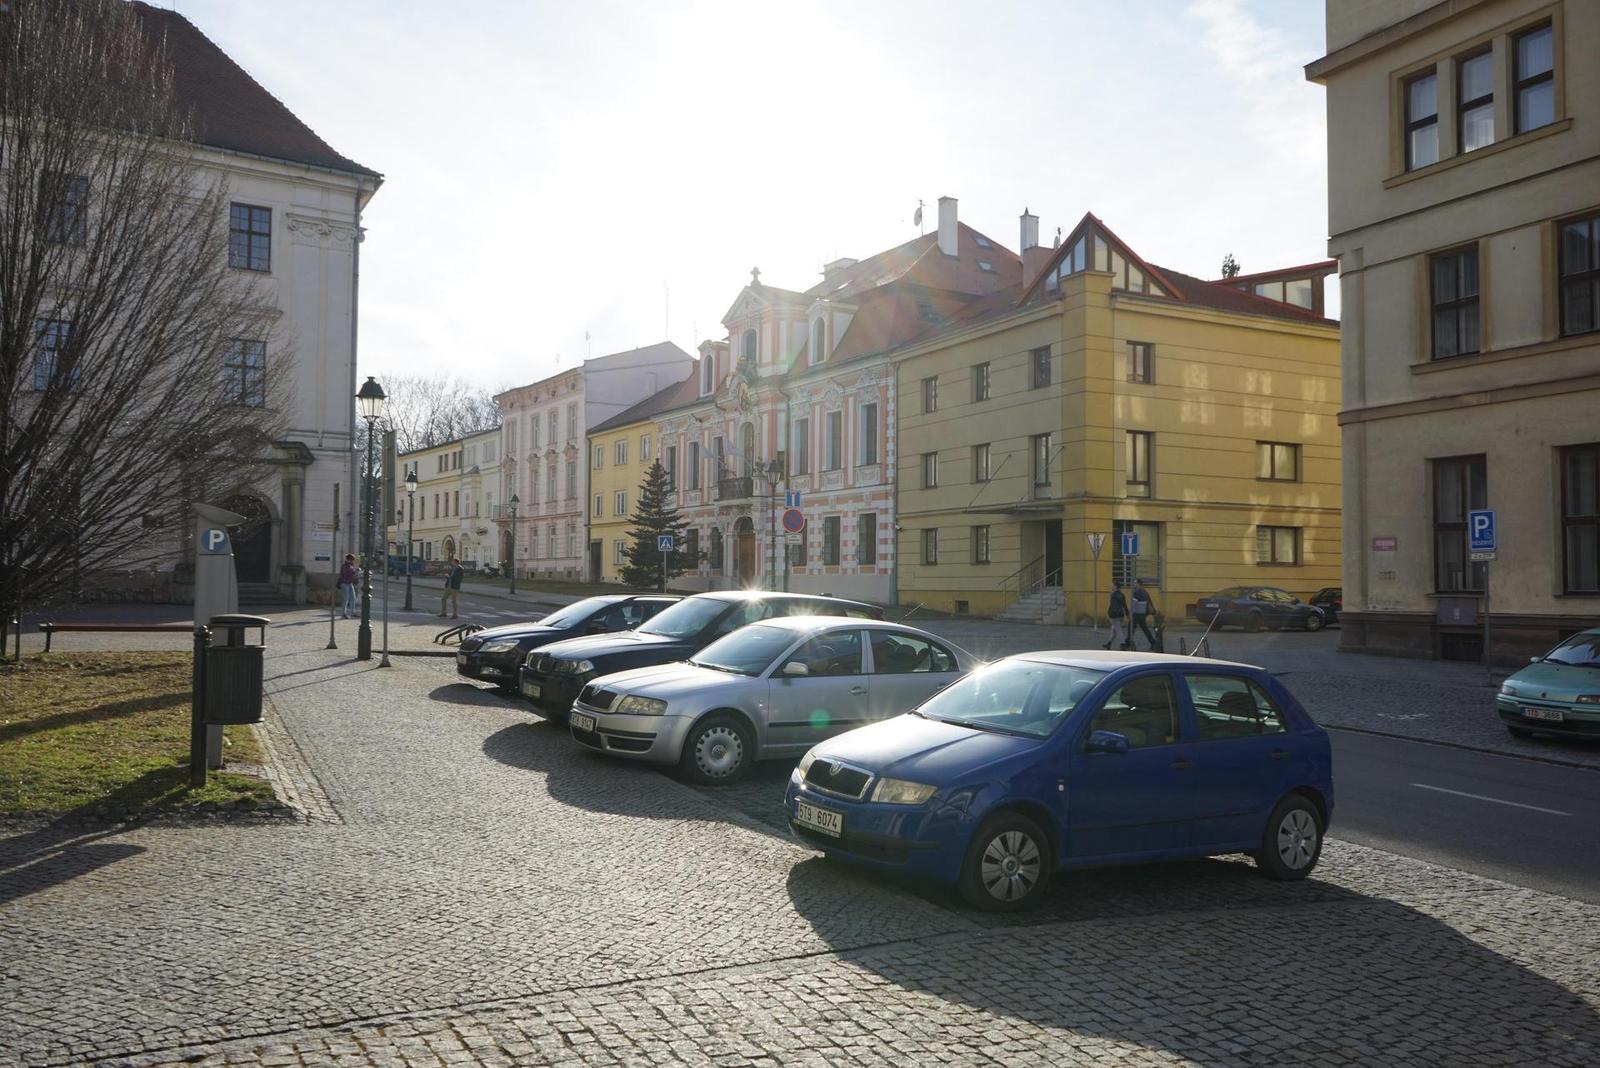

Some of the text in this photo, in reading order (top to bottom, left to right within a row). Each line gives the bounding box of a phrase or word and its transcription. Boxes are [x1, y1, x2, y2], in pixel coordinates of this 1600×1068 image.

[1474, 515, 1489, 538] P
[209, 529, 225, 550] P
[799, 804, 812, 821] 5T9
[817, 810, 838, 830] 6074
